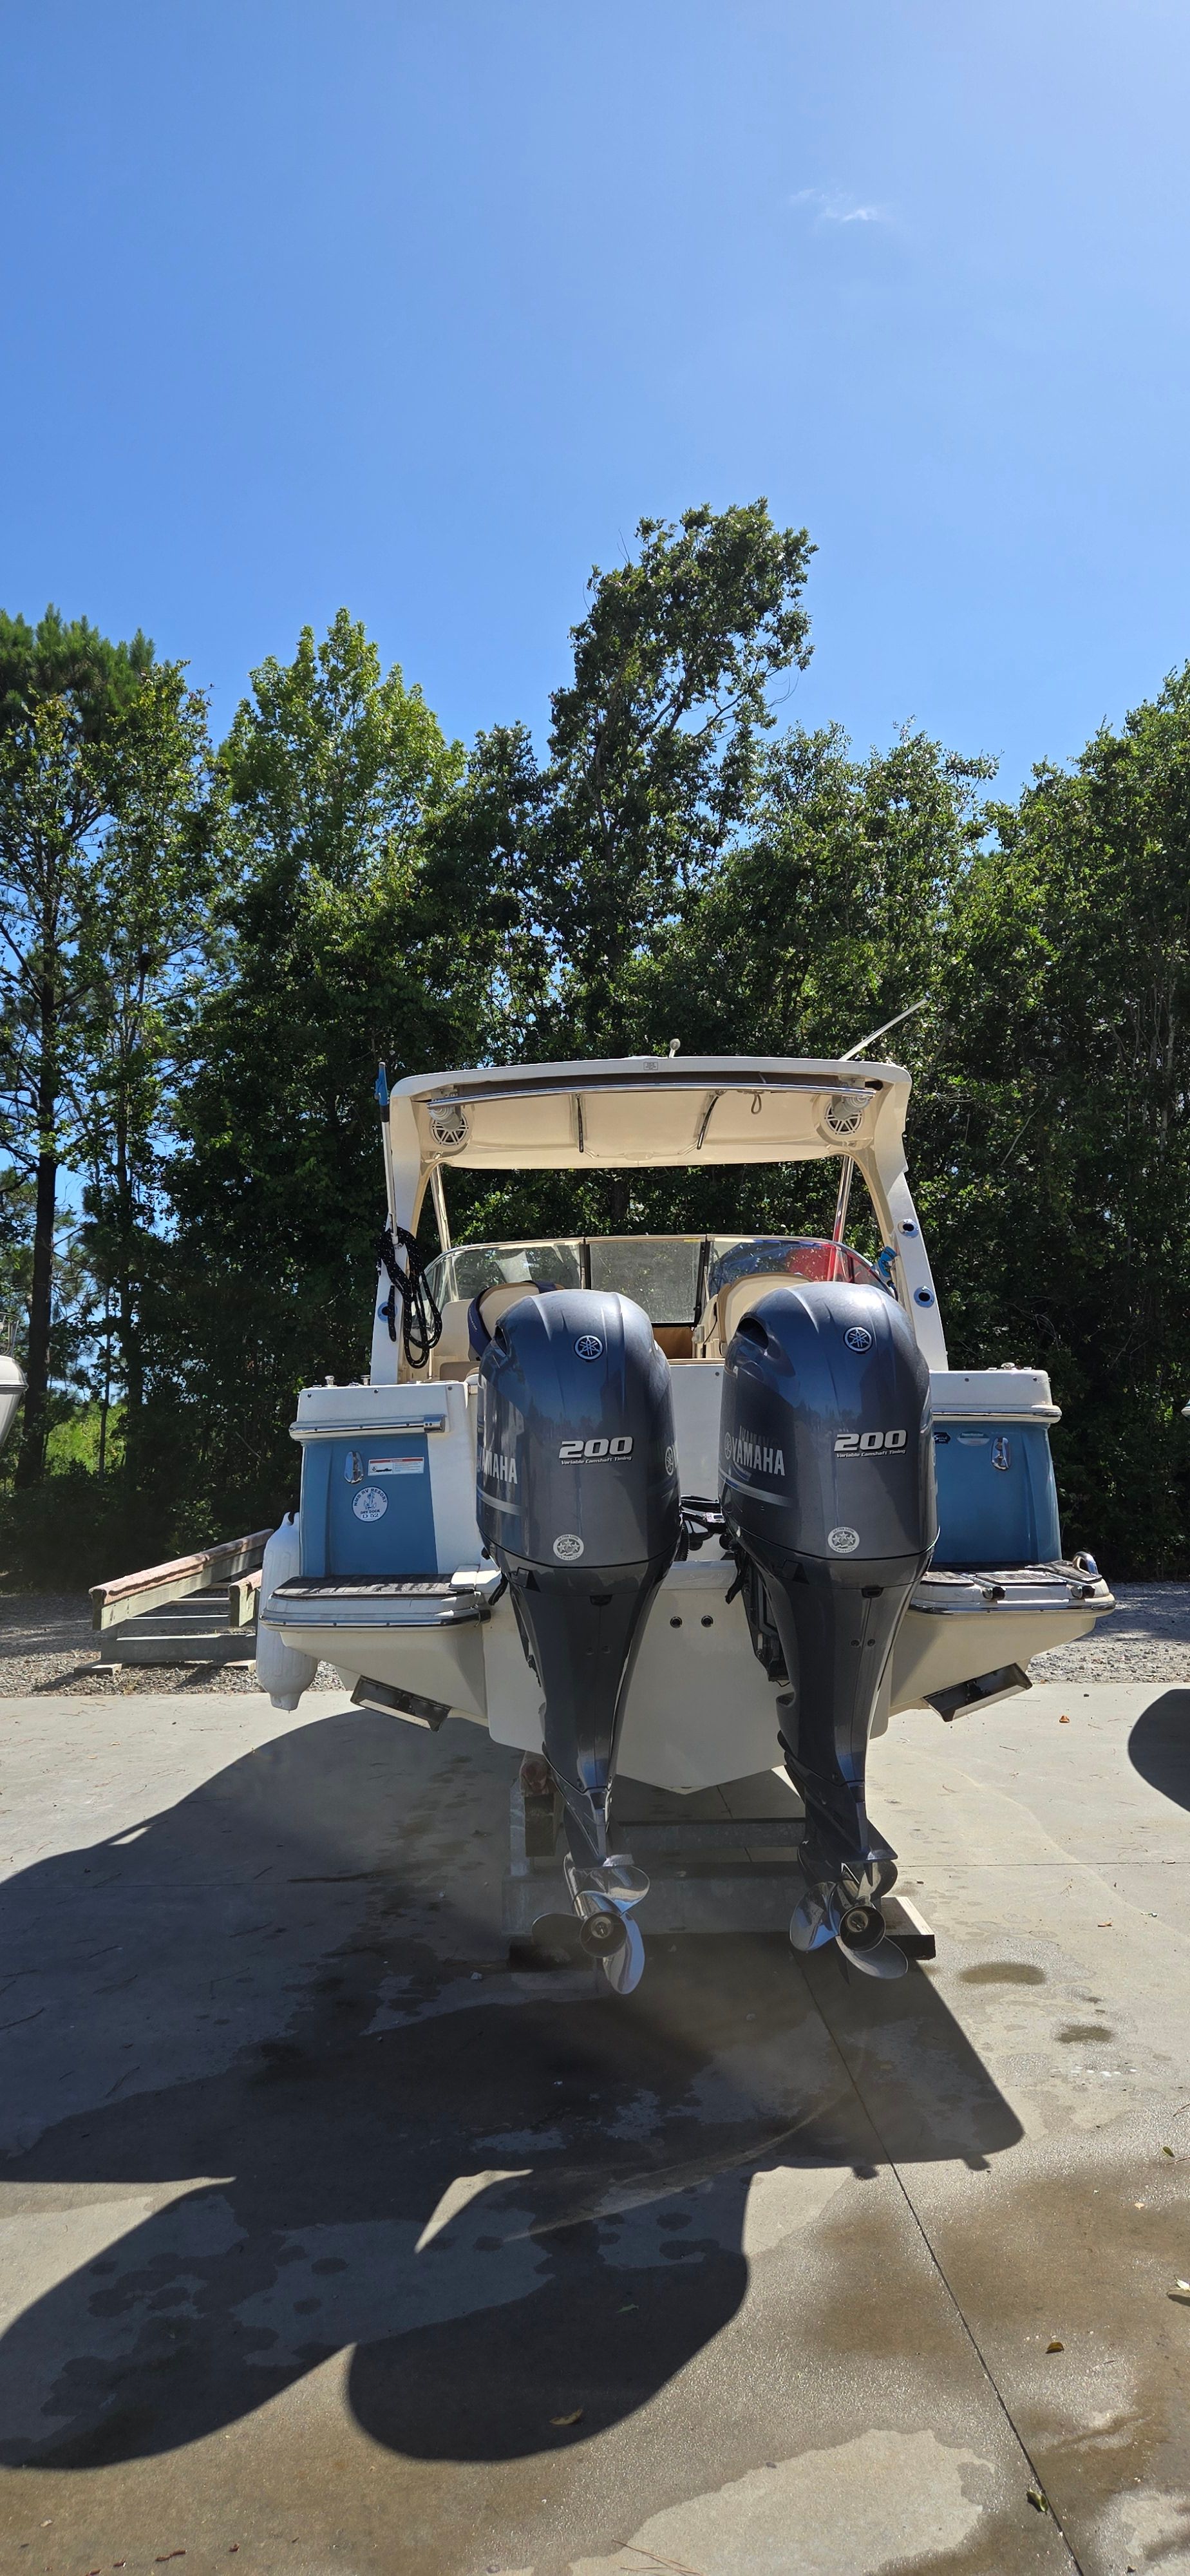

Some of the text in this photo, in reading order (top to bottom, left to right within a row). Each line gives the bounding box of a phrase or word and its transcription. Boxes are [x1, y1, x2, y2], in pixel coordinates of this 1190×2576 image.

[559, 1436, 633, 1458] 200
[834, 1430, 907, 1452] 200
[732, 1436, 786, 1476] YAMAHA
[371, 1488, 386, 1502] RESORT
